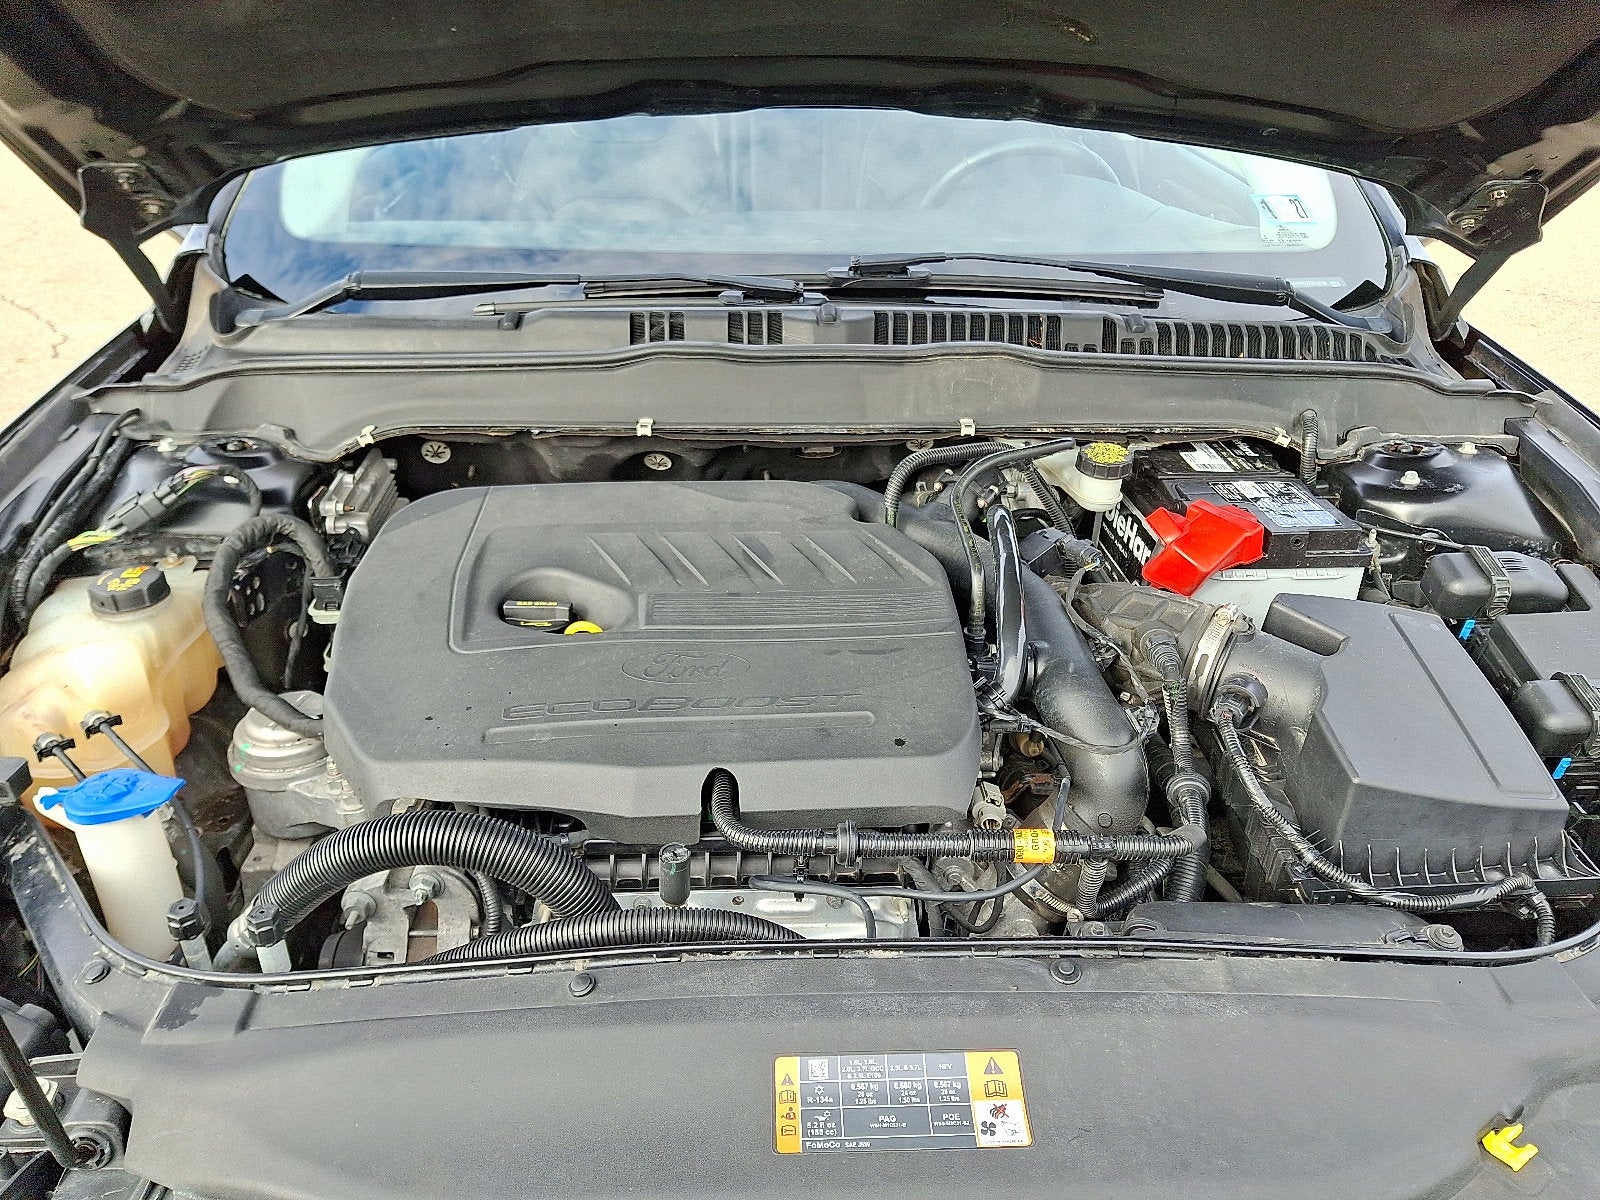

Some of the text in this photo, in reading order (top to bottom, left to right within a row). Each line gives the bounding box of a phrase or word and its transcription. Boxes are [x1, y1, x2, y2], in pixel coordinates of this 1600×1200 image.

[643, 651, 733, 680] Ford
[502, 693, 861, 721] ECOBOOST
[869, 1082, 879, 1091] kg
[912, 1081, 922, 1090] kg
[952, 1081, 962, 1089] kg
[806, 1096, 834, 1104] R-134a
[878, 1115, 897, 1123] PAG
[825, 1129, 837, 1137] cc)
[805, 1141, 841, 1149] FoMoCo
